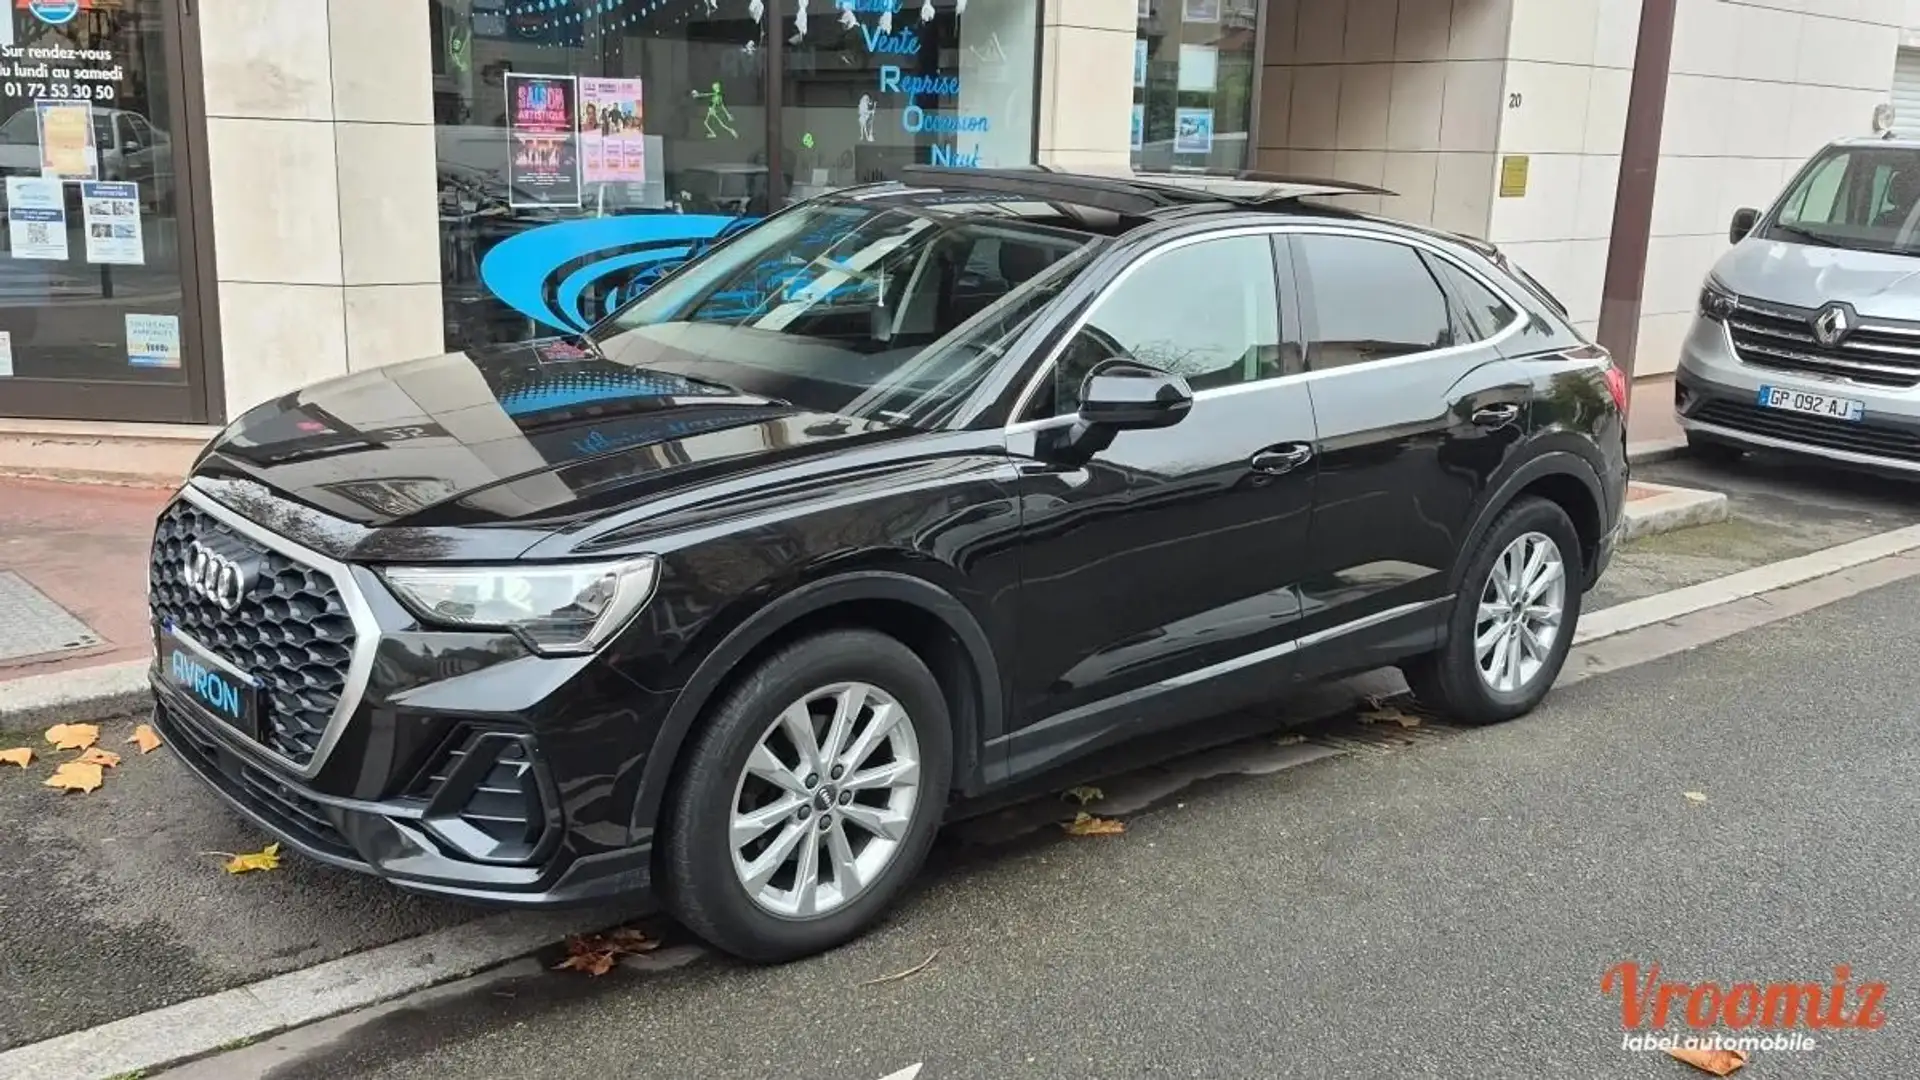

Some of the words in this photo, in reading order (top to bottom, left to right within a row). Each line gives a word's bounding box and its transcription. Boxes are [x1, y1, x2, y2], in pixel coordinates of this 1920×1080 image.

[2, 44, 24, 57] Sur
[28, 44, 112, 60] rendez-vous
[861, 24, 921, 54] Vente
[14, 61, 49, 77] lundi
[52, 68, 70, 78] au
[73, 65, 123, 80] samedi
[5, 82, 22, 97] 01
[27, 83, 47, 97] 72
[51, 83, 69, 98] 53
[72, 84, 92, 99] 30
[95, 85, 114, 100] 50
[880, 65, 961, 106] Reprise
[1508, 93, 1522, 109] 20
[903, 105, 989, 133] Occasion
[1771, 390, 1790, 406] GP
[1794, 394, 1823, 412] 092
[1828, 400, 1848, 417] AJ
[172, 649, 238, 718] AVRON
